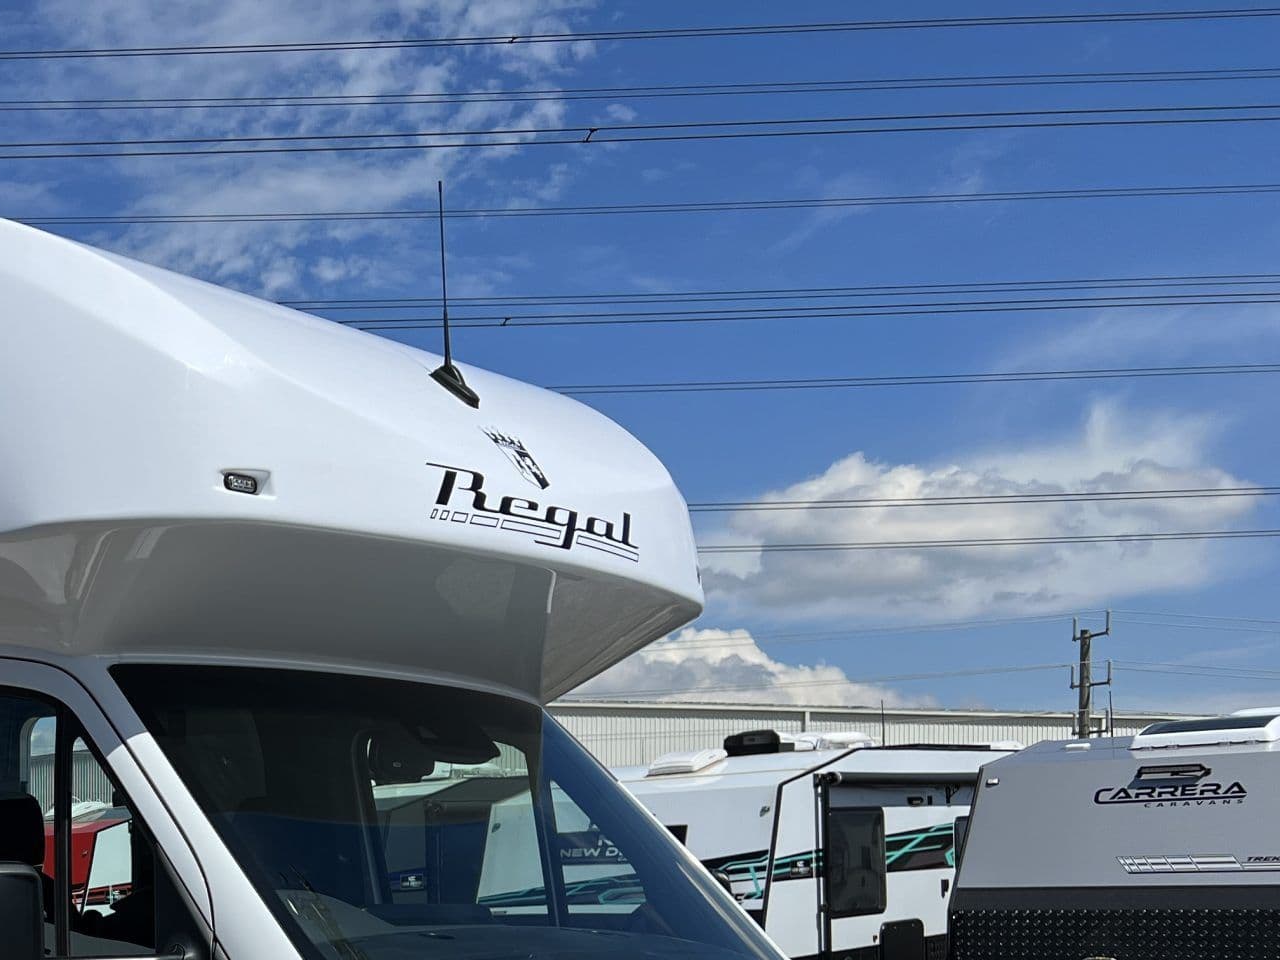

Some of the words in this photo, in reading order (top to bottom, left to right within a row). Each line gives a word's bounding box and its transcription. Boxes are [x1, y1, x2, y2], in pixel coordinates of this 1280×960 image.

[426, 462, 639, 550] Regal
[1094, 781, 1248, 805] CARRERA
[1144, 799, 1244, 809] CARAVANS
[560, 847, 601, 859] NEW
